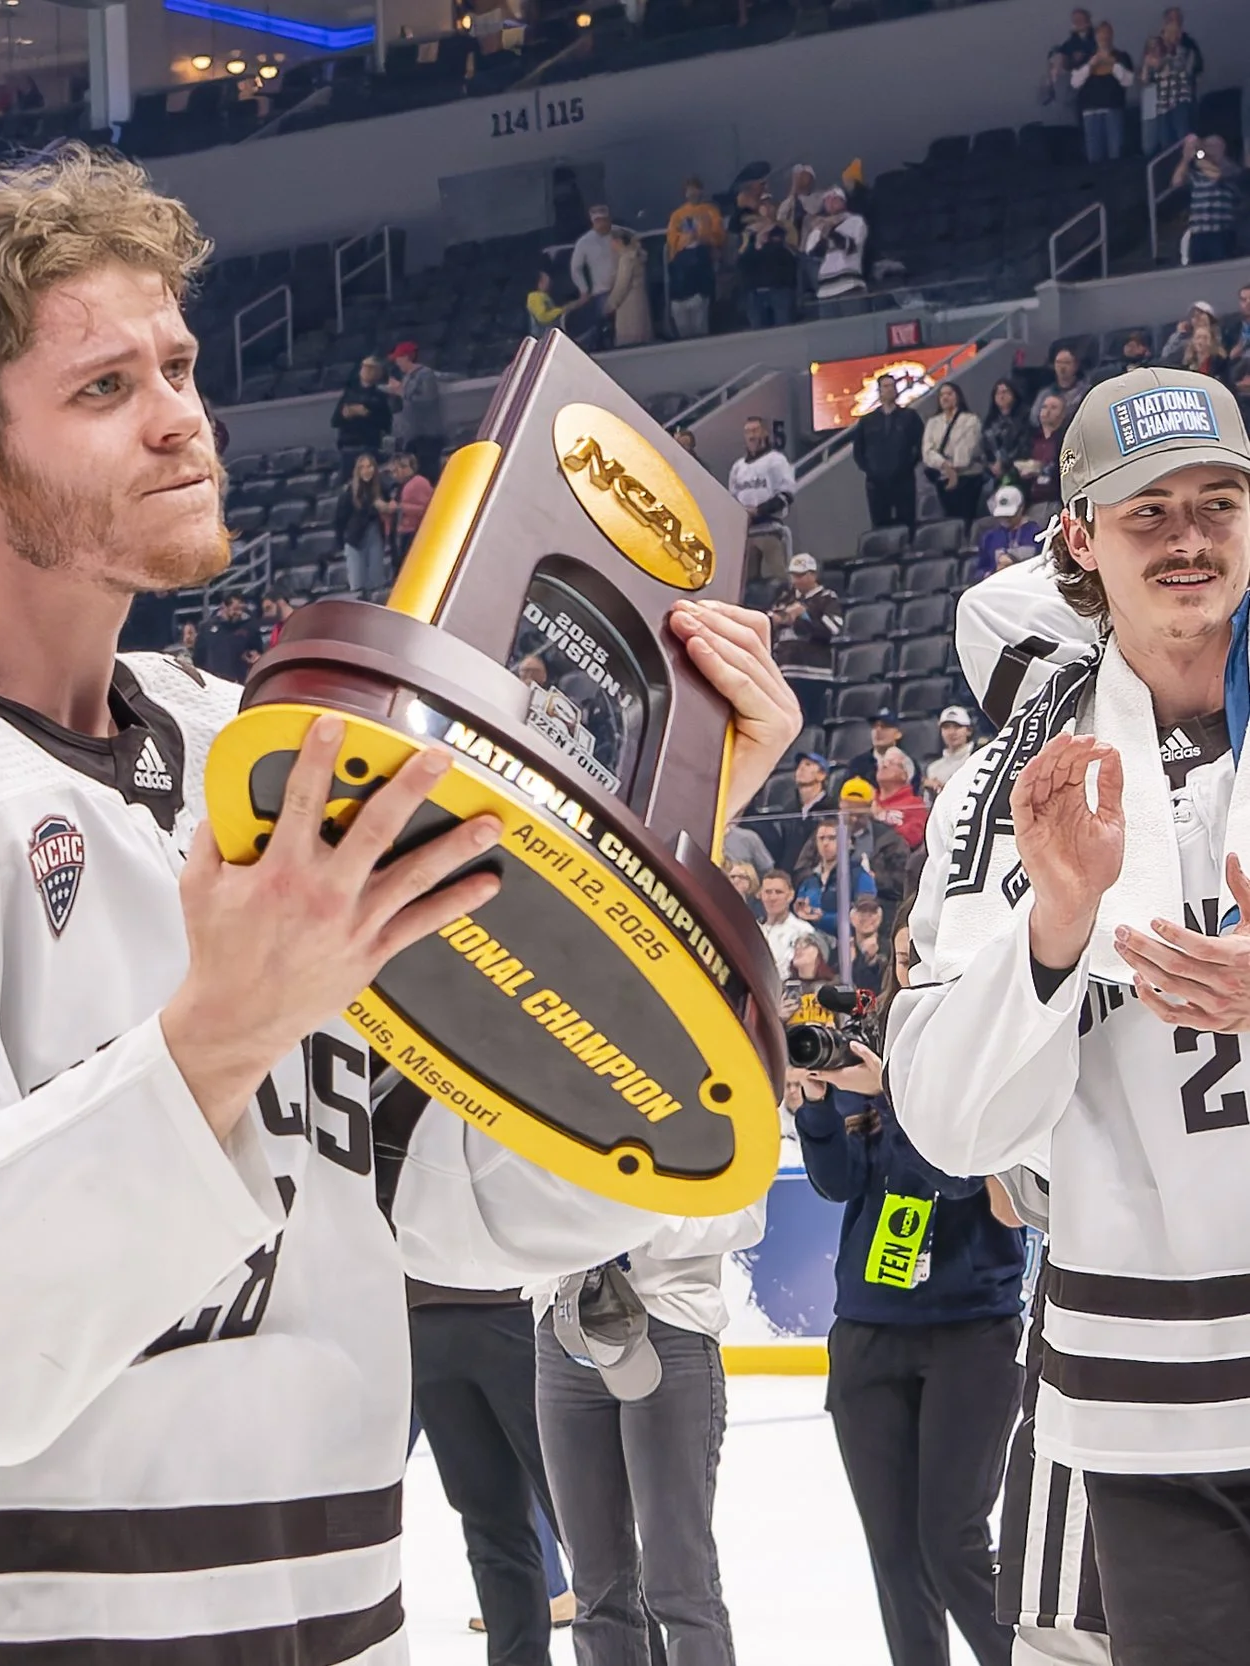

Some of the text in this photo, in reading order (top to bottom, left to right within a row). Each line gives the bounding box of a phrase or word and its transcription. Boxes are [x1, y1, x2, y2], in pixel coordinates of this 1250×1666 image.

[490, 97, 585, 137] 114 115
[1132, 391, 1207, 419] NATIONAL
[1136, 411, 1211, 440] CHAMPIONS
[563, 433, 713, 590] NCAA
[523, 603, 621, 697] DIVISION
[554, 611, 610, 665] 2025
[1161, 744, 1201, 762] adidas
[133, 770, 173, 791] adidas
[30, 834, 84, 881] NCHC
[444, 721, 731, 986] NATIONAL CHAMPION
[512, 823, 670, 962] April 12, 2025
[437, 912, 683, 1125] IONAL CHAMPION
[346, 1000, 394, 1052] ouis,
[397, 1044, 503, 1128] Missouri
[878, 1241, 913, 1284] TEN
